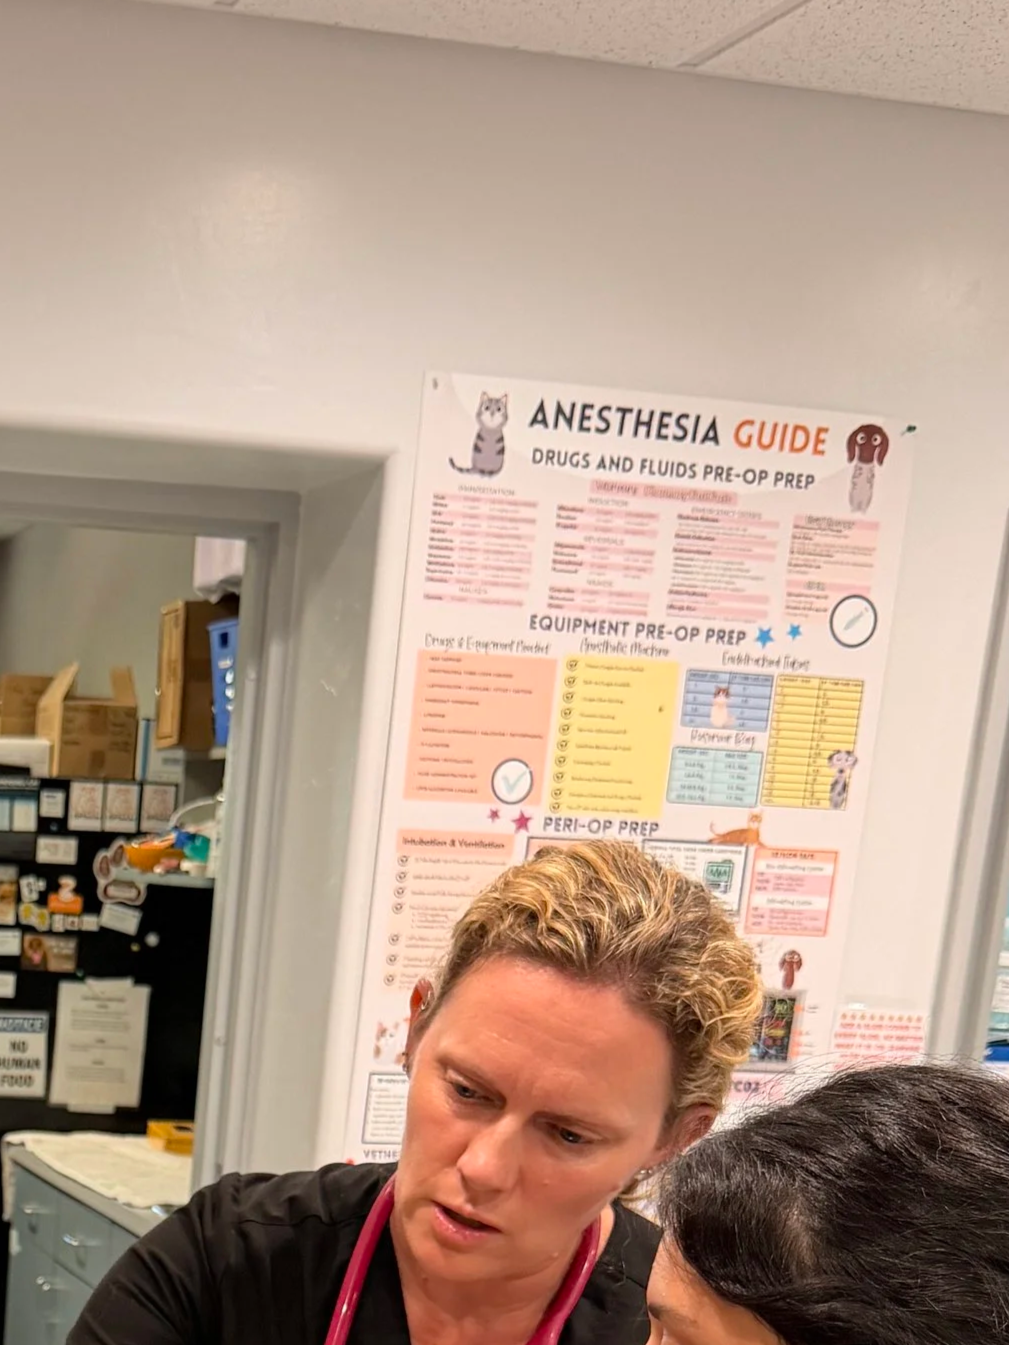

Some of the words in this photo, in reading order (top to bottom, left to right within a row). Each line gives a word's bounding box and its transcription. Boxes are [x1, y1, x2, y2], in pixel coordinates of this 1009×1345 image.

[528, 398, 720, 446] ANESTHESIA
[733, 418, 830, 456] GUIDE
[532, 448, 590, 469] DRUGS
[596, 455, 633, 473] AND
[640, 458, 697, 480] FLUIDS
[703, 464, 768, 486] PRE-OP
[773, 471, 815, 490] PREP
[529, 614, 630, 637] EQUIPMENT
[635, 623, 700, 643] PRE-OP
[705, 628, 747, 646] PREP
[543, 817, 613, 834] PERI-OP
[618, 820, 660, 836] PREP
[0, 1073, 35, 1088] FOOD
